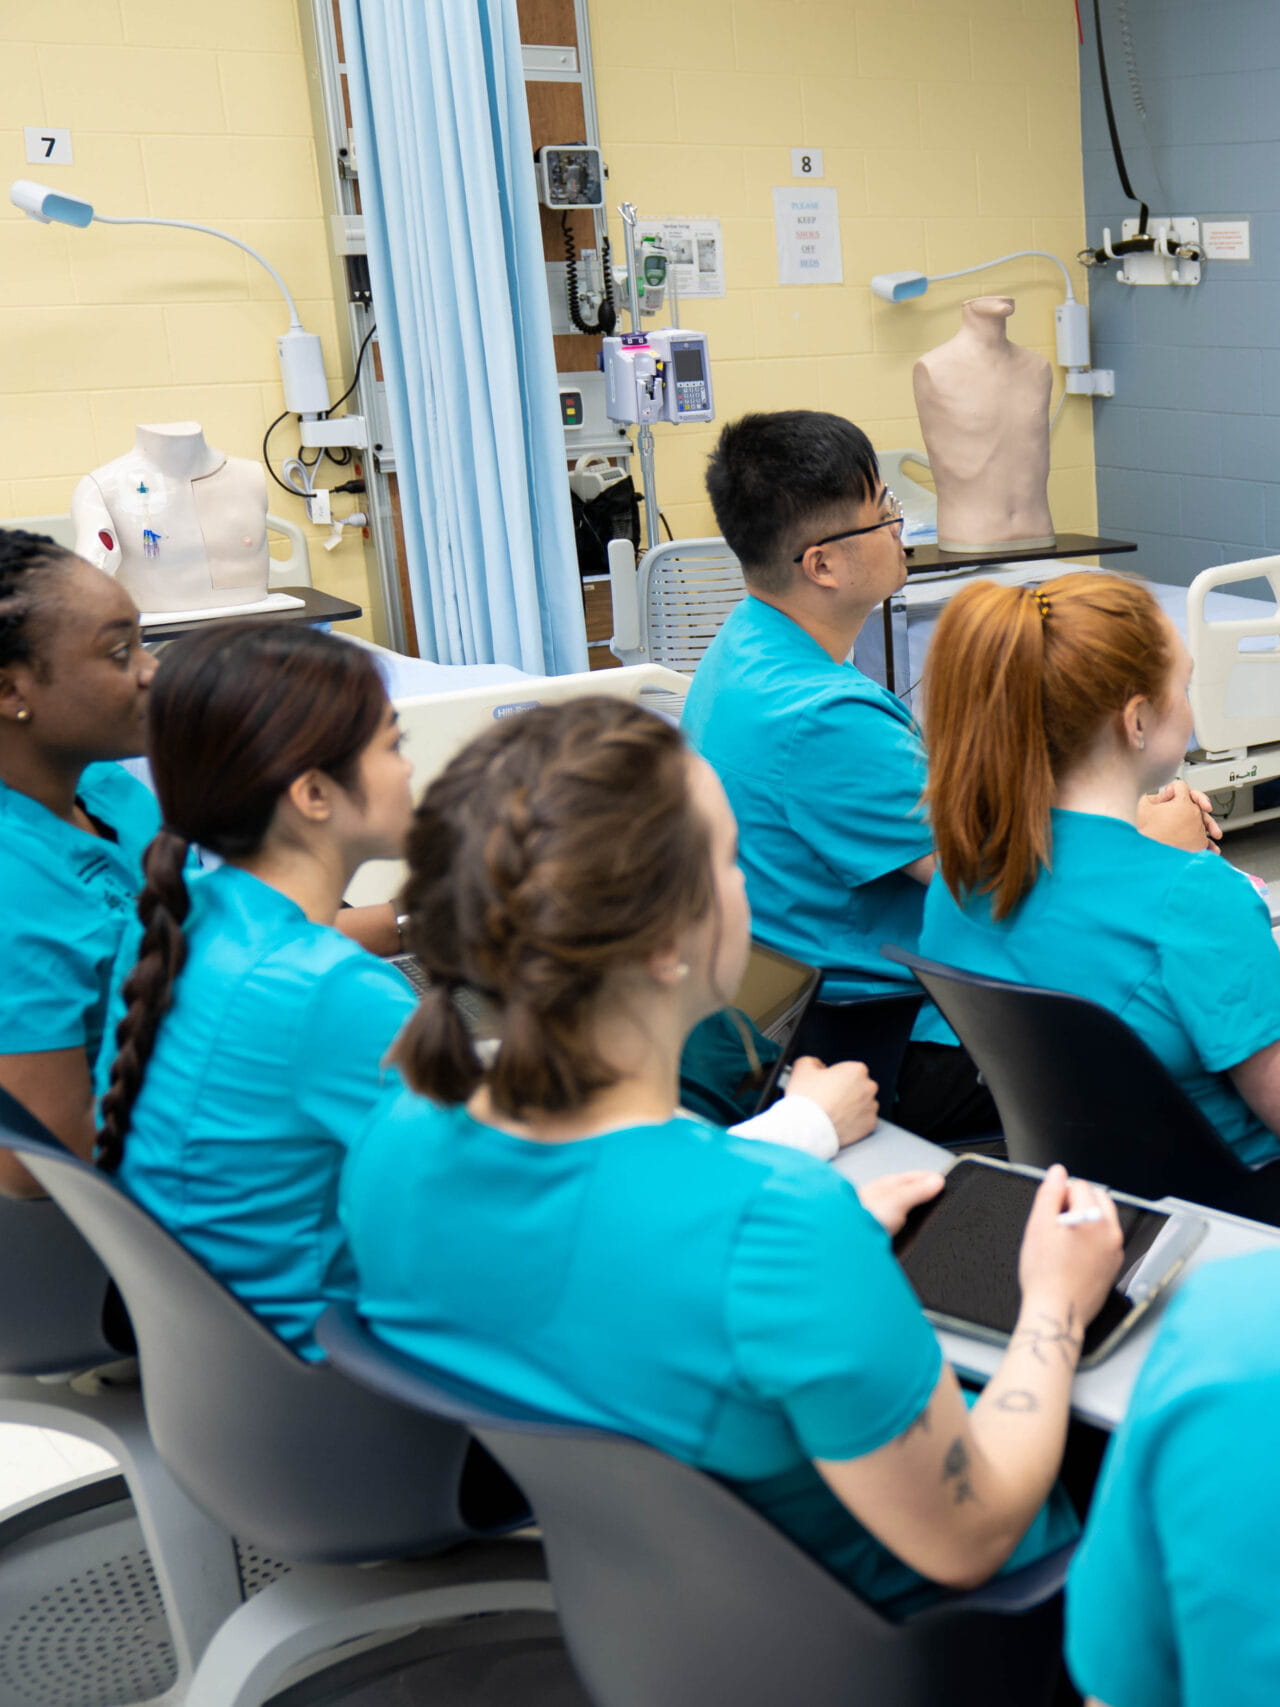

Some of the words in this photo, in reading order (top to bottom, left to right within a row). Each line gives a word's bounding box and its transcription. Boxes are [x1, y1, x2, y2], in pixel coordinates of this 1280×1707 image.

[41, 136, 56, 158] 7
[801, 155, 812, 173] 8
[791, 201, 819, 210] PLEASE
[797, 216, 816, 224] KEEP
